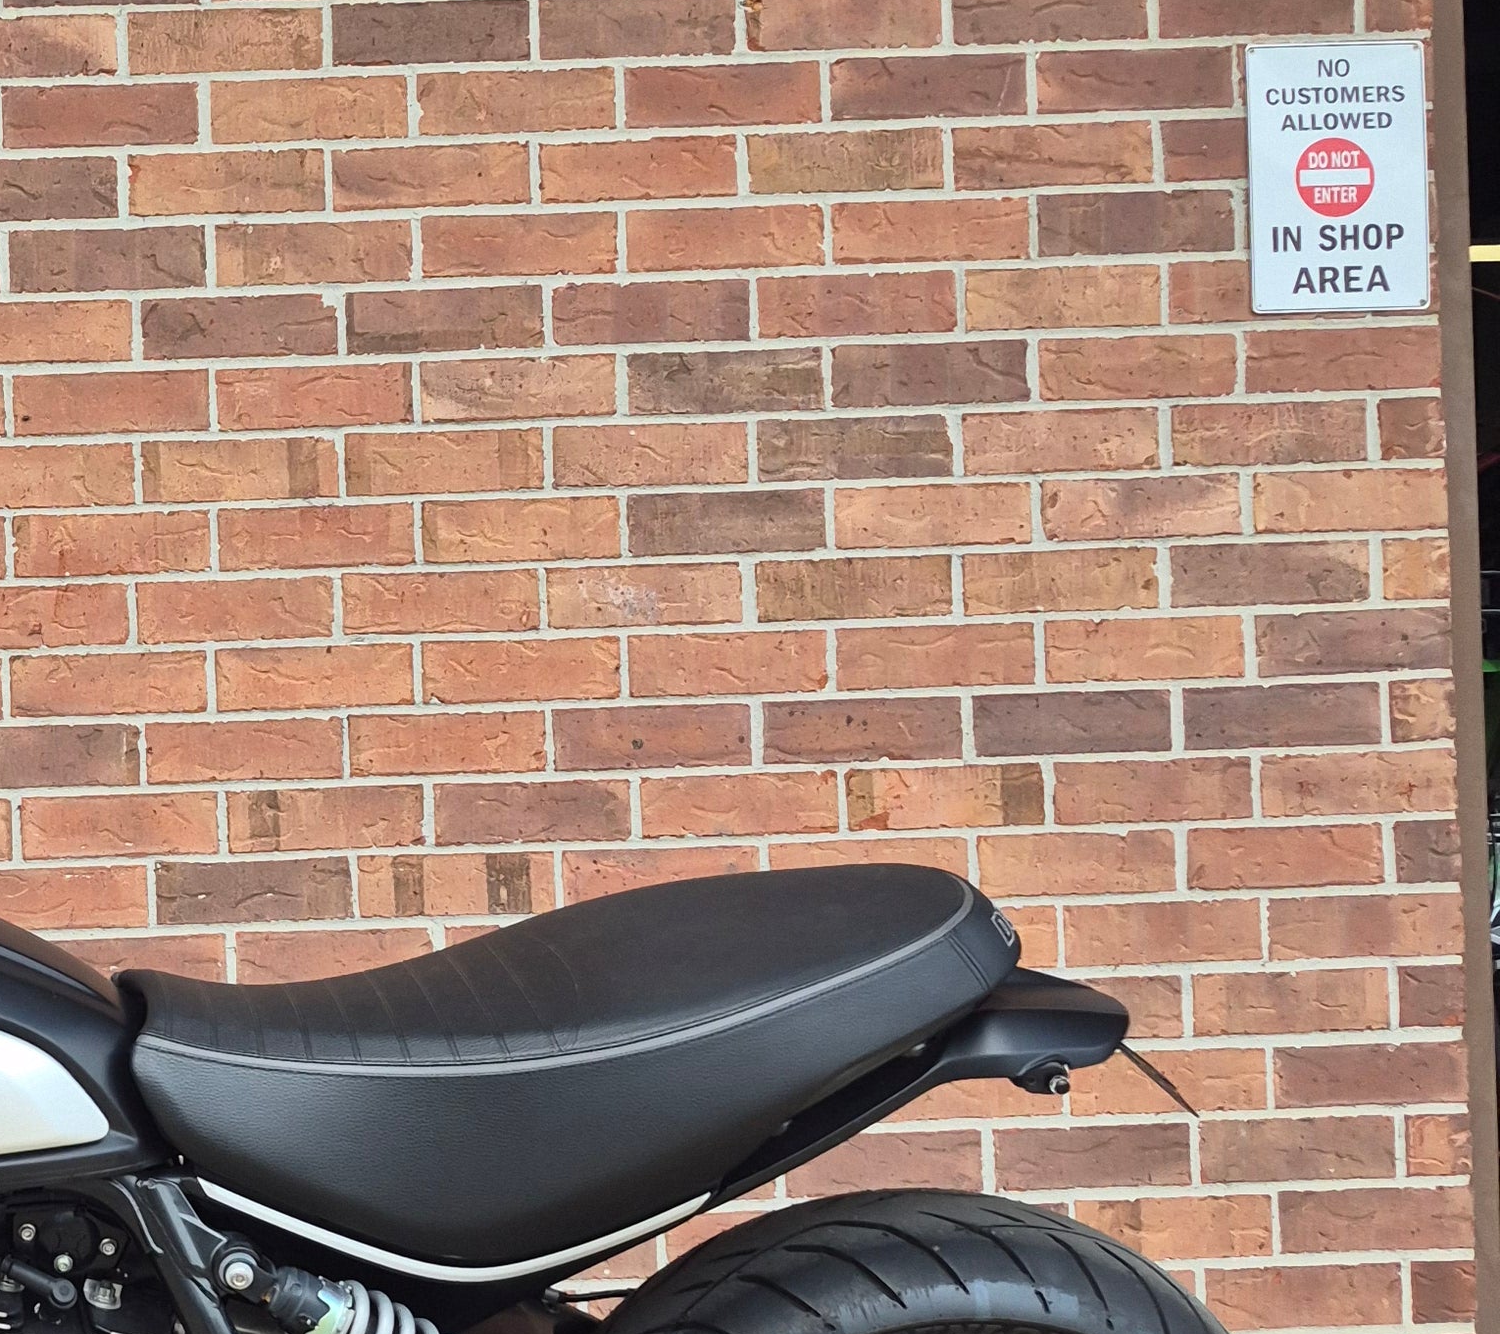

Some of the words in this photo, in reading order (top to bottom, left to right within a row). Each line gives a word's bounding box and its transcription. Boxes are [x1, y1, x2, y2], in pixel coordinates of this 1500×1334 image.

[1317, 58, 1351, 78] NO
[1265, 84, 1406, 106] CUSTOMERS
[1281, 111, 1393, 132] ALLOWED
[1307, 151, 1330, 169] DO
[1331, 150, 1361, 168] NOT
[1313, 186, 1358, 205] ENTER
[1272, 225, 1302, 253] IN
[1318, 223, 1405, 252] SHOP
[1292, 264, 1391, 295] AREA
